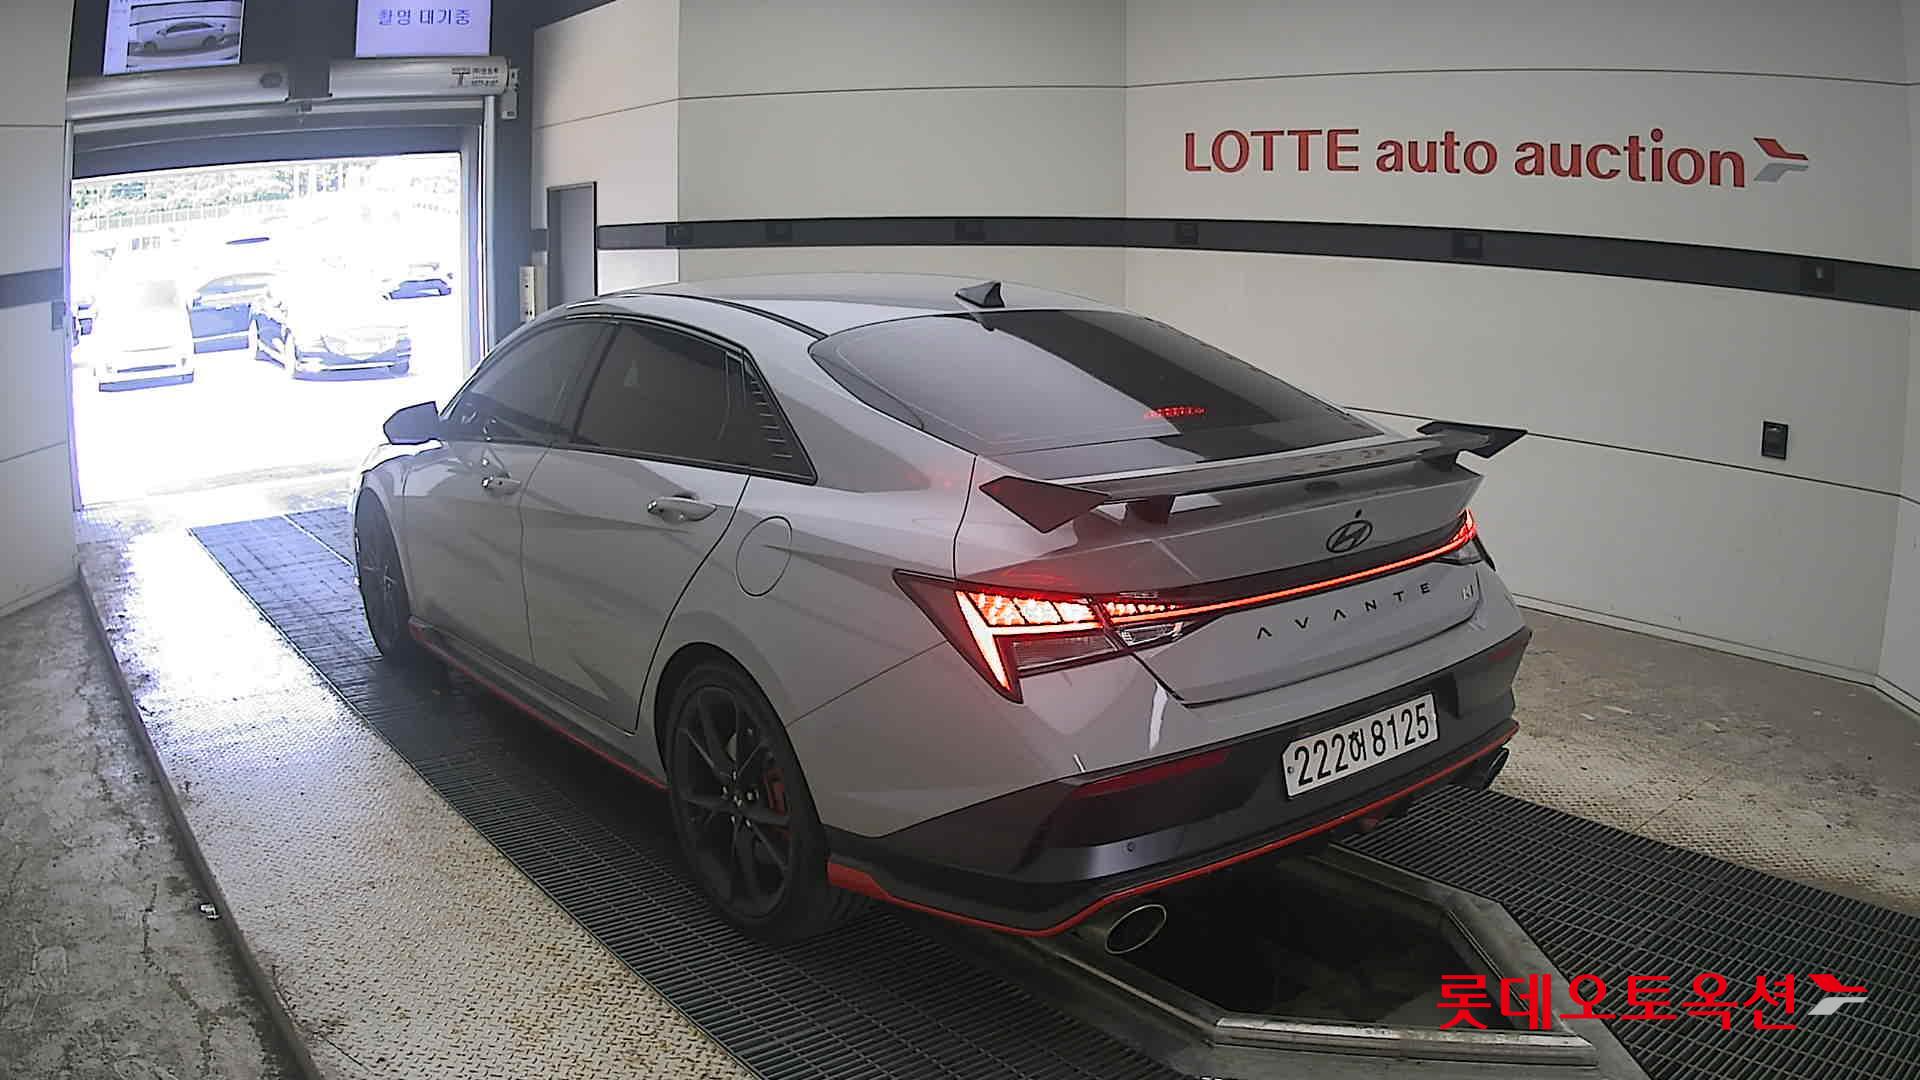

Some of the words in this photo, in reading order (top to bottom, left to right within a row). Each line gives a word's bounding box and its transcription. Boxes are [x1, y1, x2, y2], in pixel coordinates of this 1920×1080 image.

[419, 8, 472, 26] 대기중
[1184, 129, 1360, 173] LOTTE
[1376, 132, 1499, 176] auto
[1514, 127, 1745, 188] auction
[1257, 582, 1432, 640] AVANTE
